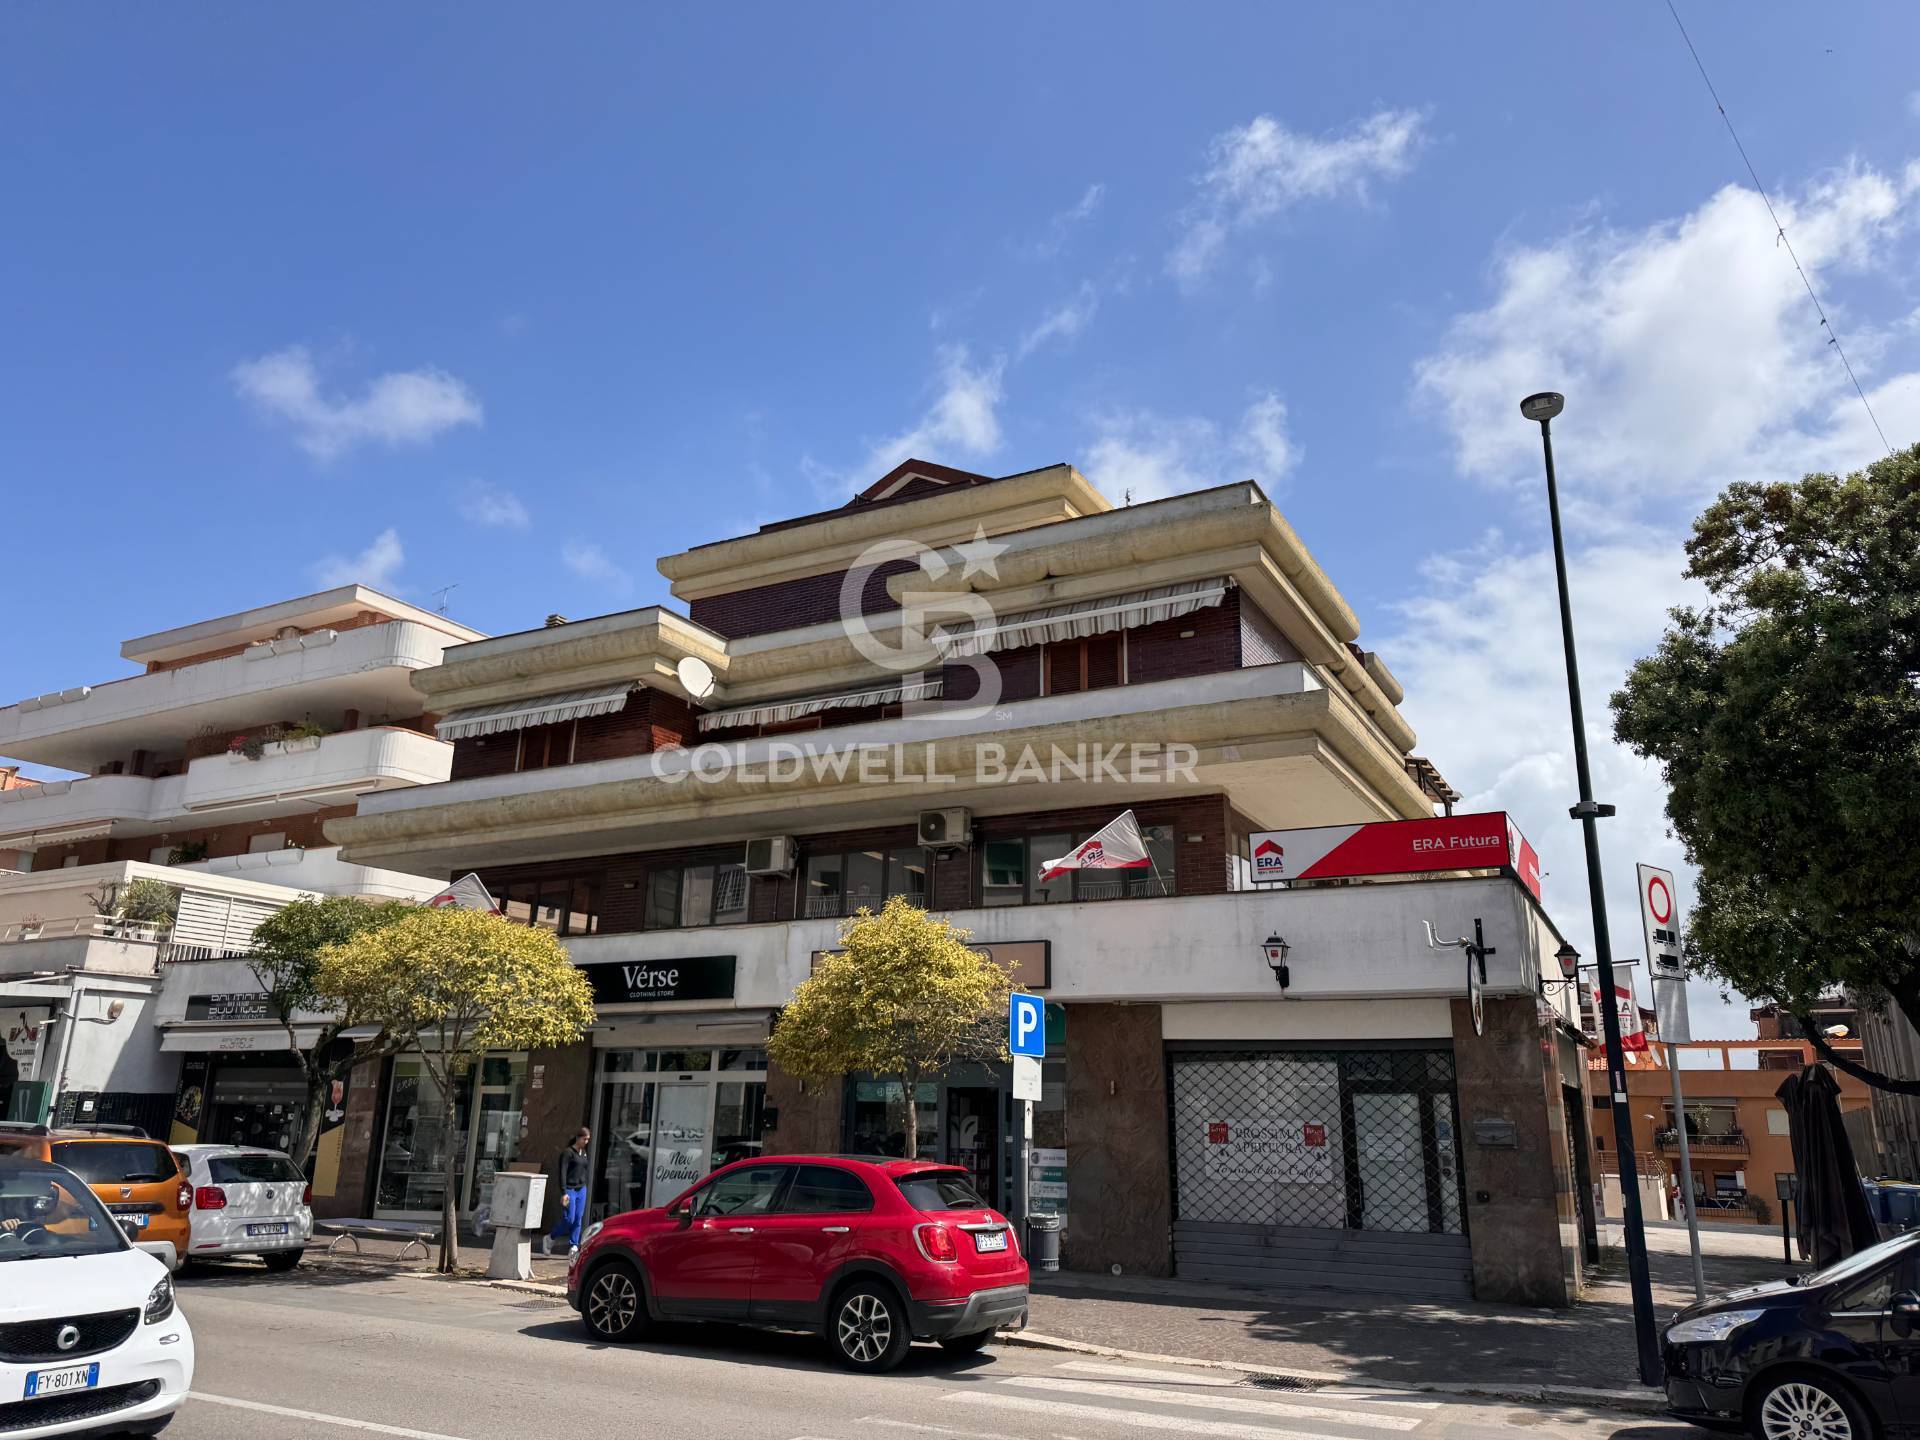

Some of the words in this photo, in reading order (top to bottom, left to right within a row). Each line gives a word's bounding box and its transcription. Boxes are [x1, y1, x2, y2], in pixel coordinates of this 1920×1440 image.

[1412, 837, 1445, 851] ERA
[1450, 835, 1500, 848] Futura
[1257, 857, 1283, 867] ERA
[621, 965, 679, 989] Vérse
[629, 991, 656, 999] CLOTHING
[1018, 1001, 1037, 1047] P
[1235, 1127, 1302, 1140] PROSSIMA
[1234, 1142, 1303, 1154] APERTURA
[669, 1151, 693, 1166] New
[656, 1165, 700, 1185] Opening
